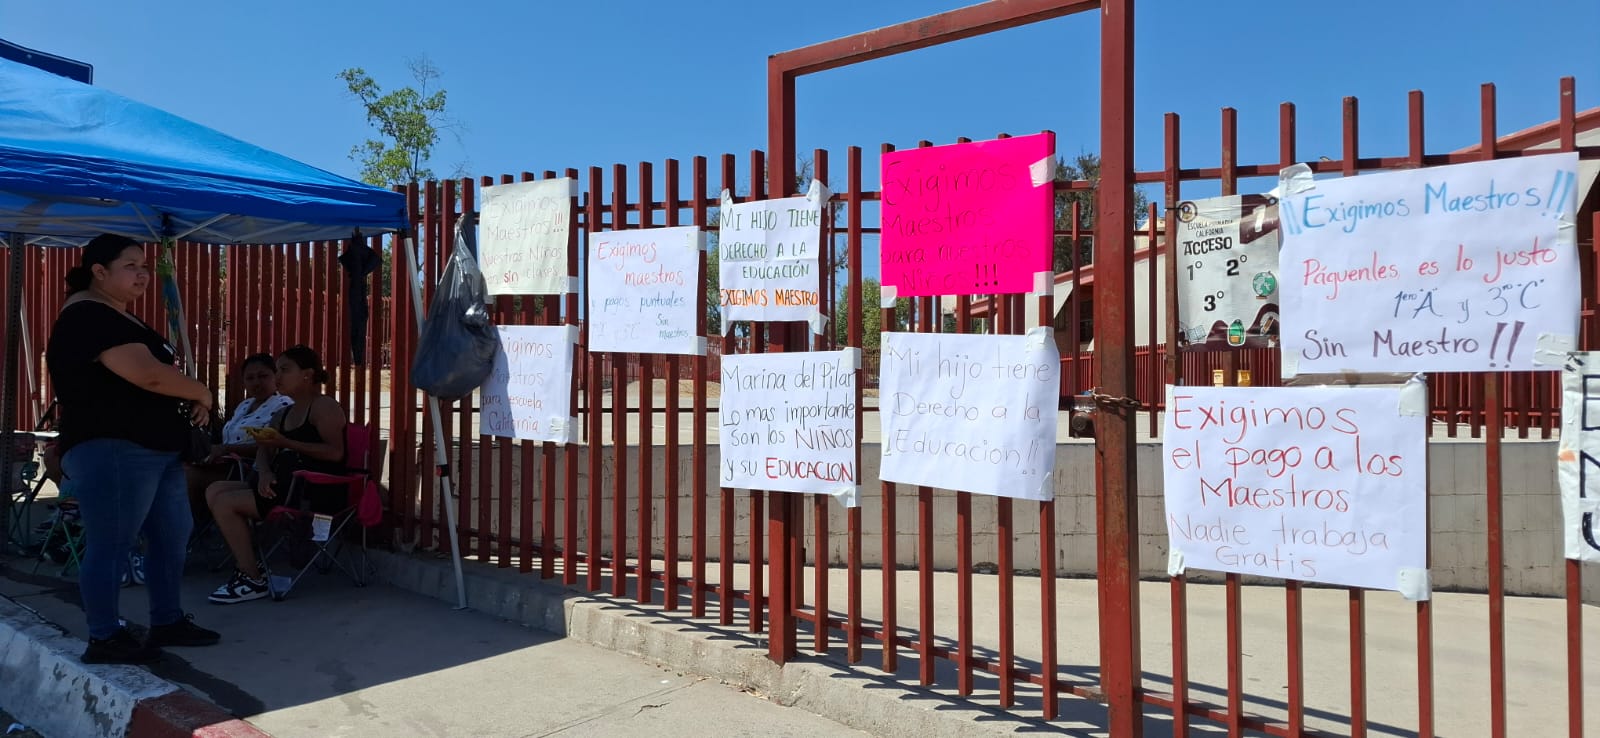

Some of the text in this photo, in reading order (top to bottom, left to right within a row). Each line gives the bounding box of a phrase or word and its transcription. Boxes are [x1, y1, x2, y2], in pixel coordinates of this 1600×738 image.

[884, 161, 1017, 212] Exigimos
[1424, 169, 1576, 220] Maestros!!
[721, 207, 820, 231] MI HIJO TIENE
[881, 203, 995, 238] Maestros
[597, 241, 657, 271] Exigimos
[720, 241, 807, 260] DERECHO A LA
[938, 238, 1031, 262] nuestros
[1183, 236, 1233, 256] ACCESO
[504, 269, 519, 283] sin
[624, 263, 685, 287] maestros
[742, 260, 810, 280] EDUCACIÓN
[1303, 236, 1558, 300] Páguenles es lo justo
[640, 290, 685, 313] puntuales
[720, 288, 769, 307] EXIGIMOS
[1457, 298, 1470, 324] y
[656, 312, 670, 326] Sin
[658, 327, 690, 340] maestros
[1302, 330, 1348, 360] Sin
[722, 358, 856, 393] Marina del Pilar
[938, 341, 983, 400] hijo
[991, 344, 1051, 382] tiene
[509, 391, 543, 413] escuela
[722, 391, 855, 431] Lo mas importante
[893, 391, 1041, 423] Derecho a la
[489, 409, 539, 433] California
[1173, 395, 1359, 444] Exigimos
[731, 424, 853, 451] Son los NIÑOS
[1172, 434, 1403, 478] el pago a los
[725, 457, 854, 483] y su EDUCACION
[1200, 473, 1350, 513] Maestros
[1169, 513, 1390, 555] Nadie trabaja
[1215, 545, 1318, 578] Gratis
